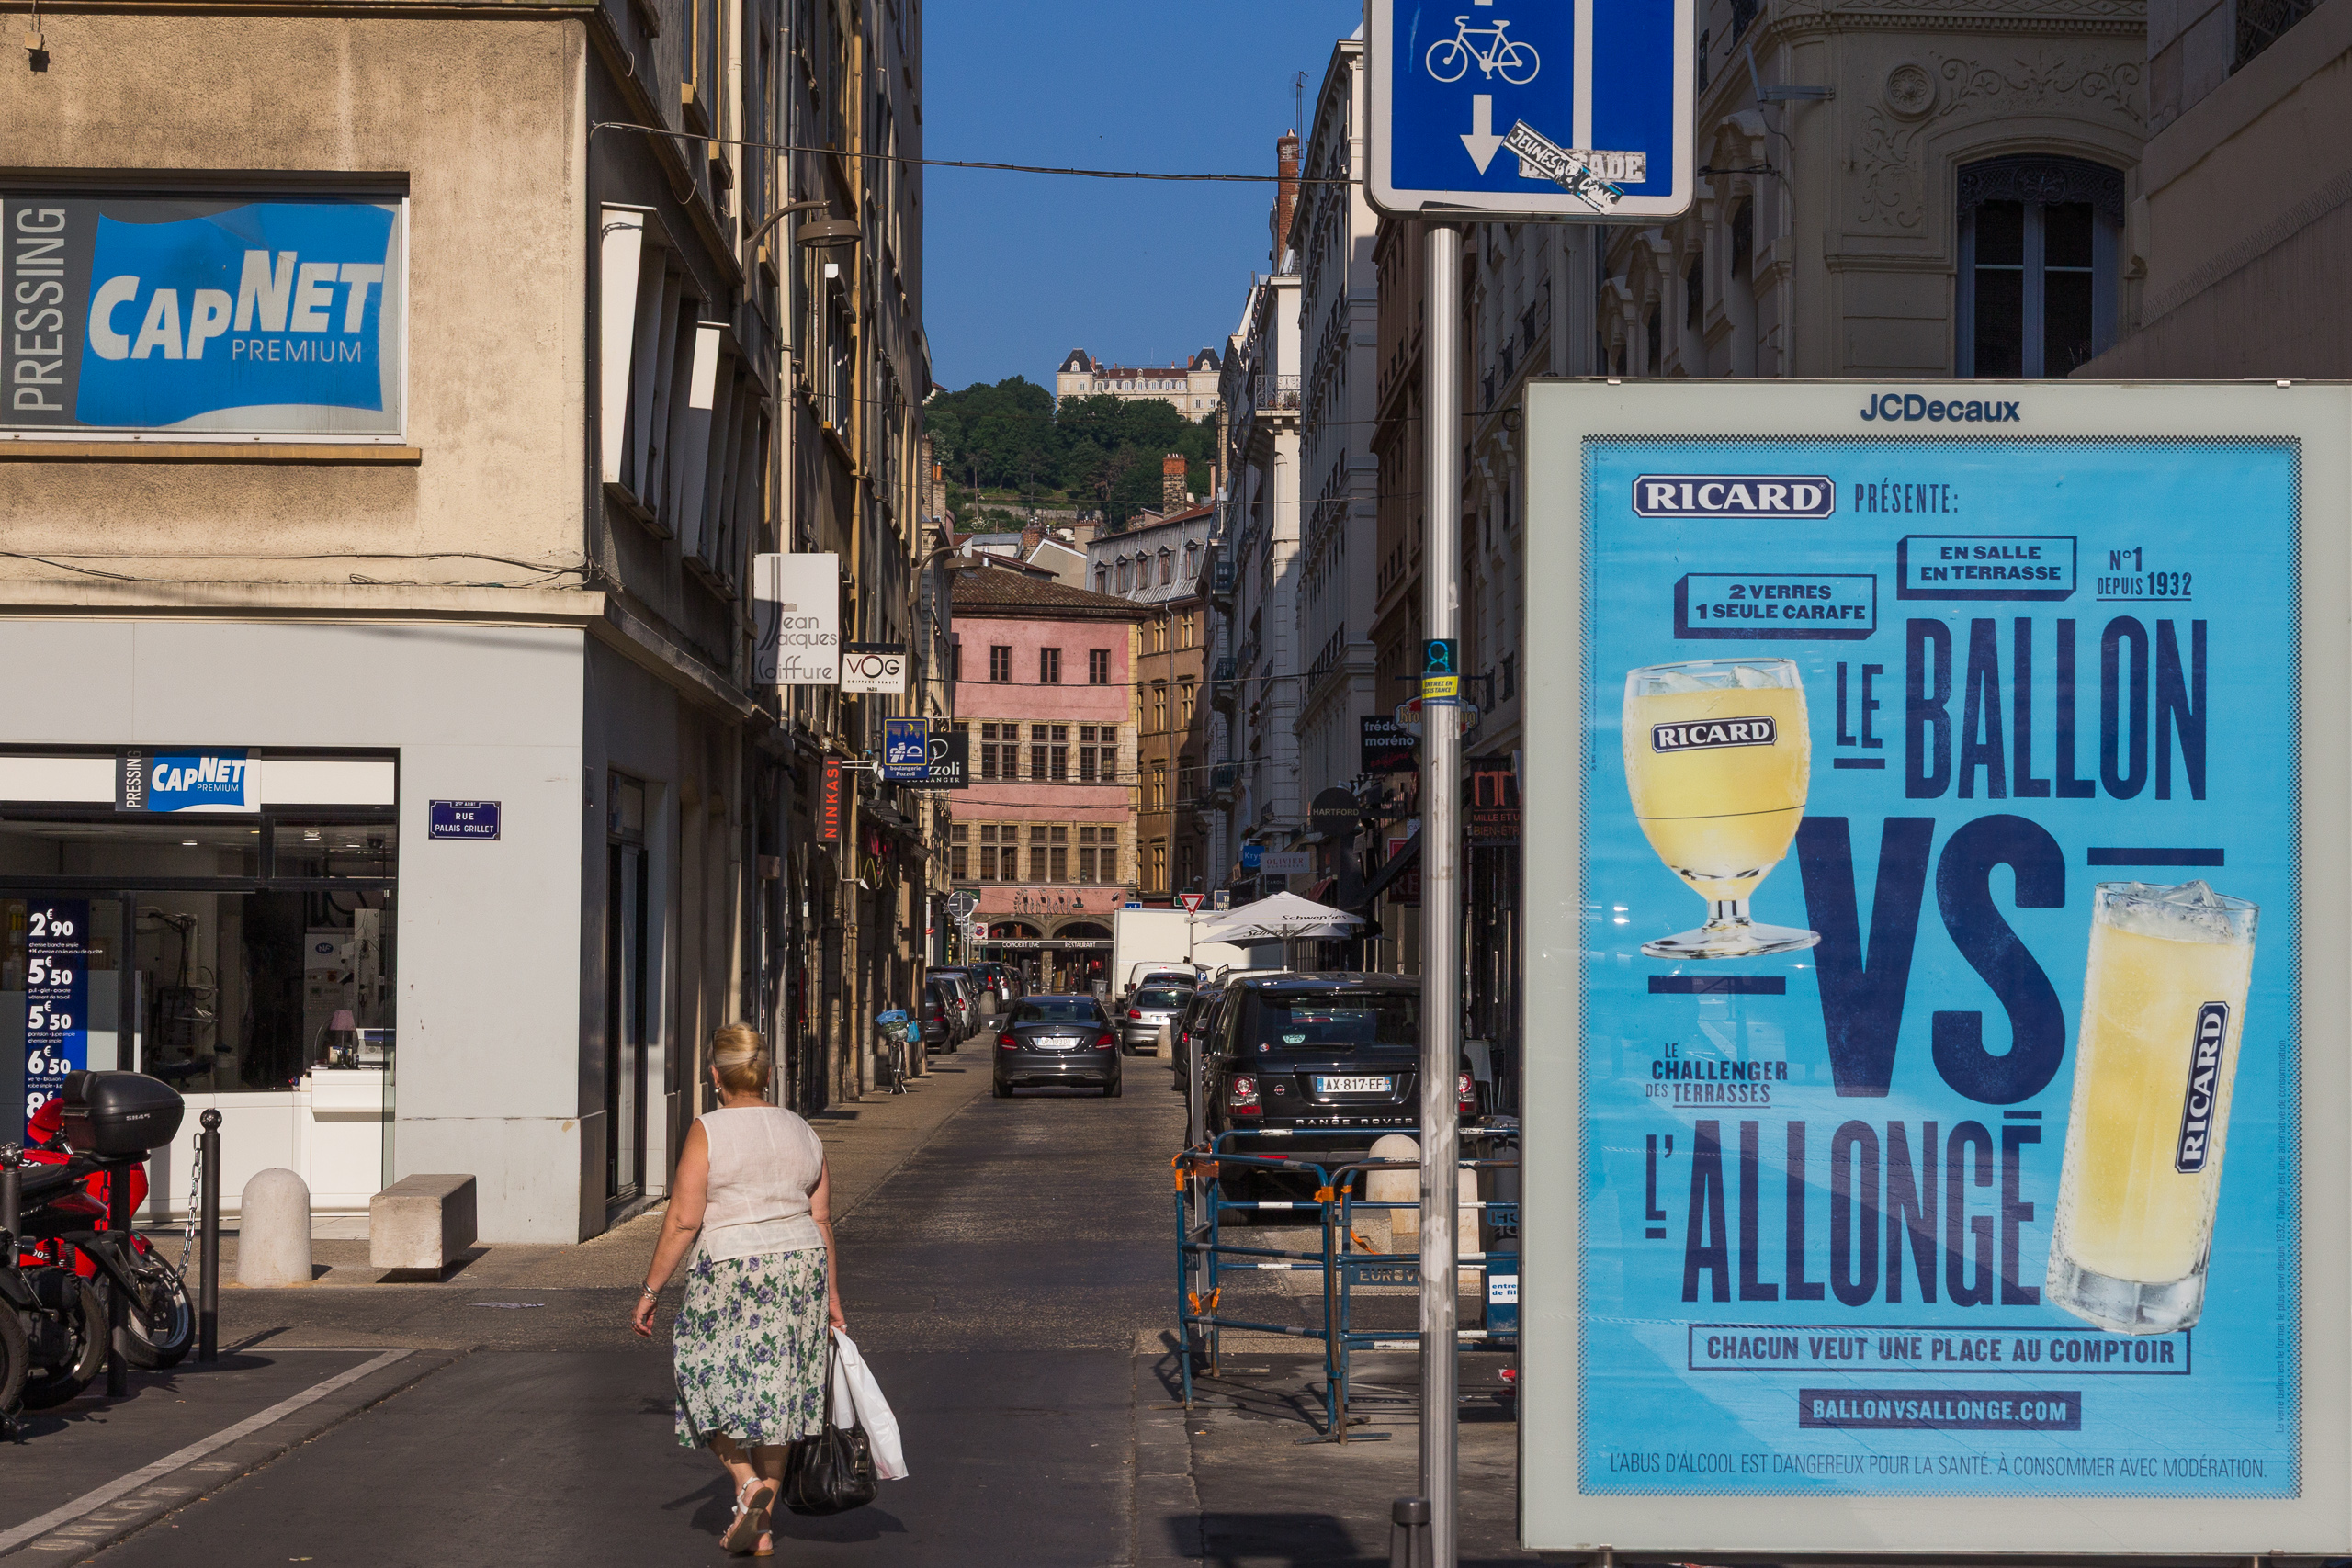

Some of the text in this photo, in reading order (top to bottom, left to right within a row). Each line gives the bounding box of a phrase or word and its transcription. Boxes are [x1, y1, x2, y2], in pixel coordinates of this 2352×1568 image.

[13, 209, 65, 410] PRESSING
[232, 339, 361, 363] PREMIUM
[1860, 393, 2020, 423] JCDecaux
[1855, 478, 1959, 513] PRÉSENTE:
[1940, 546, 2041, 559] EN SALLE
[1921, 565, 2061, 581] EN TERRASSE
[1729, 584, 1832, 600] 2 VERRES
[2098, 571, 2192, 596] DEPUIS 1932
[1695, 604, 1866, 620] 1 SEULE CARAFE
[758, 655, 832, 680] Coiffure
[846, 654, 900, 679] VOG
[1837, 615, 2207, 800] LE BALLON
[1365, 735, 1415, 747] moréno
[126, 750, 141, 808] PRESSING
[197, 784, 239, 792] PREMIUM
[825, 761, 840, 838] NINKASI
[455, 812, 475, 820] RUE
[1313, 808, 1360, 817] HARTFORD
[1474, 814, 1498, 822] MILLE
[435, 824, 494, 833] PALAIS GRILLET
[1267, 857, 1304, 865] OLIVIER
[1796, 814, 2066, 1105] VS
[1665, 1043, 1679, 1058] LE
[1652, 1060, 1788, 1081] CHALLENGER
[1326, 1078, 1384, 1090] AX-817-EF
[1645, 1083, 1770, 1103] DES TERRASSES
[2277, 1100, 2286, 1110] de
[2276, 1111, 2285, 1154] alternative
[2277, 1172, 2285, 1184] est
[2276, 1245, 2287, 1271] depuis
[2276, 1274, 2284, 1292] servi
[2276, 1294, 2287, 1311] plus
[2275, 1323, 2284, 1348] format
[1707, 1336, 2175, 1364] CHACUN VEUT UNE PLACE AU COMPTOIR
[2276, 1360, 2284, 1373] est
[2275, 1375, 2284, 1399] ballon
[1813, 1399, 2066, 1421] BALLONVSALLONGE.COM
[2275, 1423, 2284, 1433] Le
[1611, 1452, 2267, 1478] L'ABUS D'ALCOOL EST DANGEREUX POUR LA SANTÉ. À CONSOMMER AVEC MODÉRATION.
